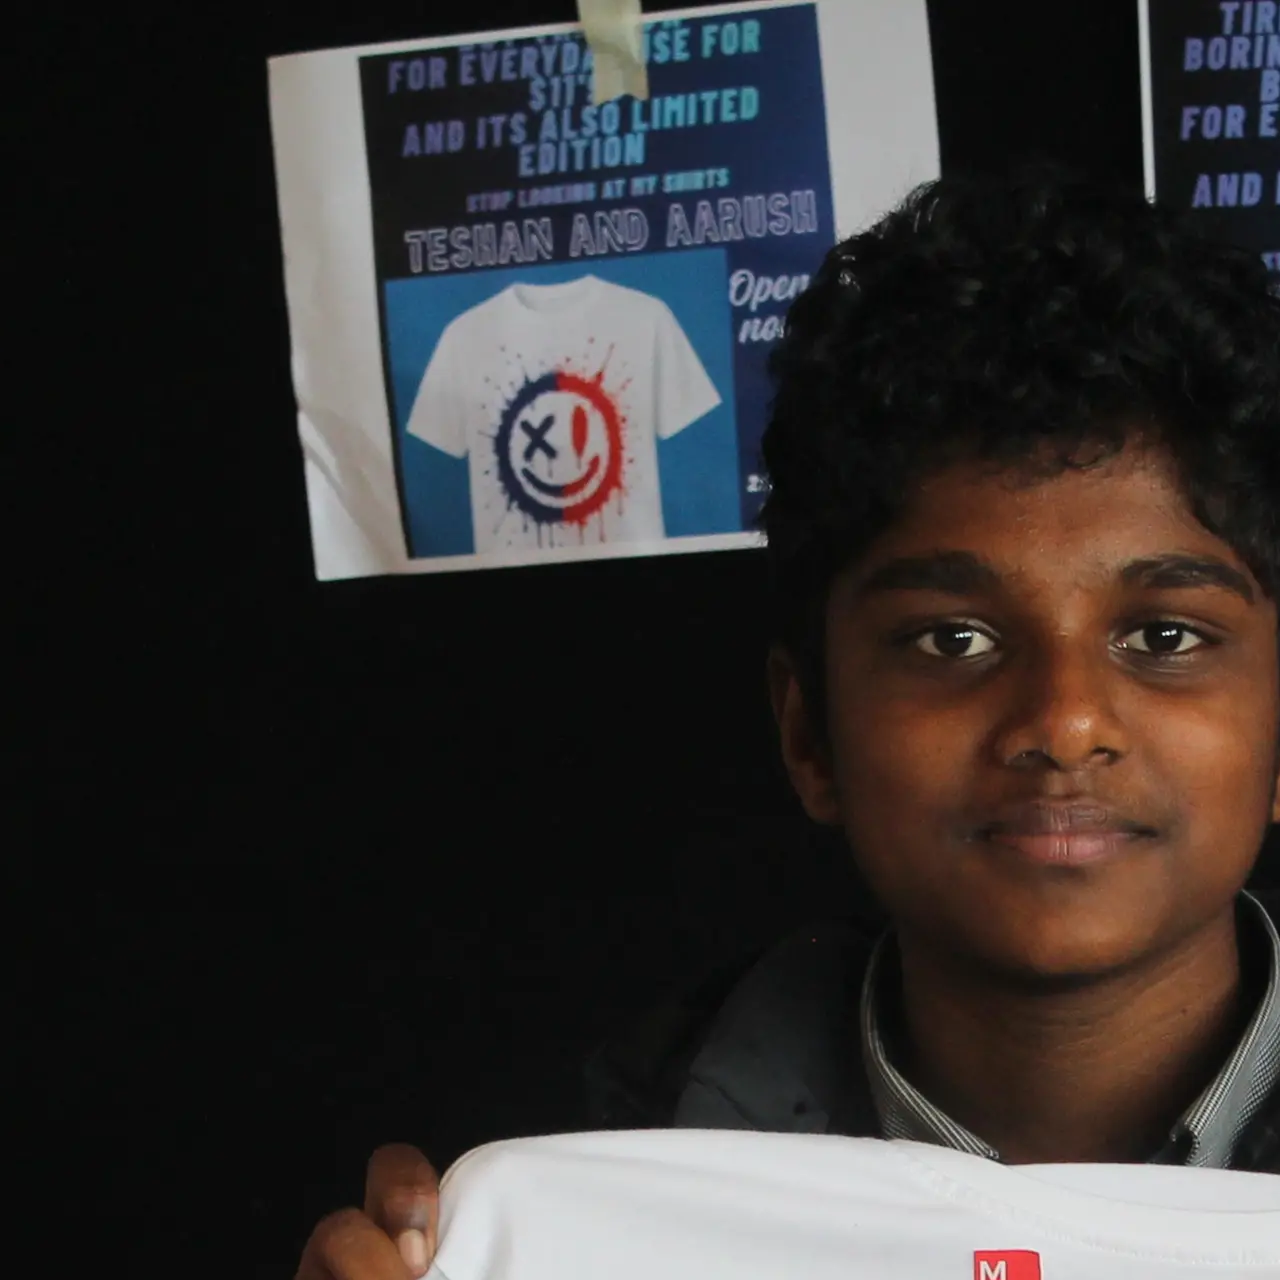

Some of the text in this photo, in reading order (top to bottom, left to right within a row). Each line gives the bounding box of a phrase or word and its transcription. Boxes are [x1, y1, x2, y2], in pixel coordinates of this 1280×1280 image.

[388, 56, 447, 93] FOR
[701, 19, 761, 58] FOR
[402, 86, 759, 157] AND ITS ALSO LIMITED
[1180, 104, 1246, 141] FOR
[518, 132, 645, 178] EDITION
[601, 178, 625, 199] AT
[630, 175, 658, 196] MY
[1191, 172, 1263, 208] AND
[404, 189, 818, 273] TESHAN AND AARUSH
[739, 316, 786, 343] no
